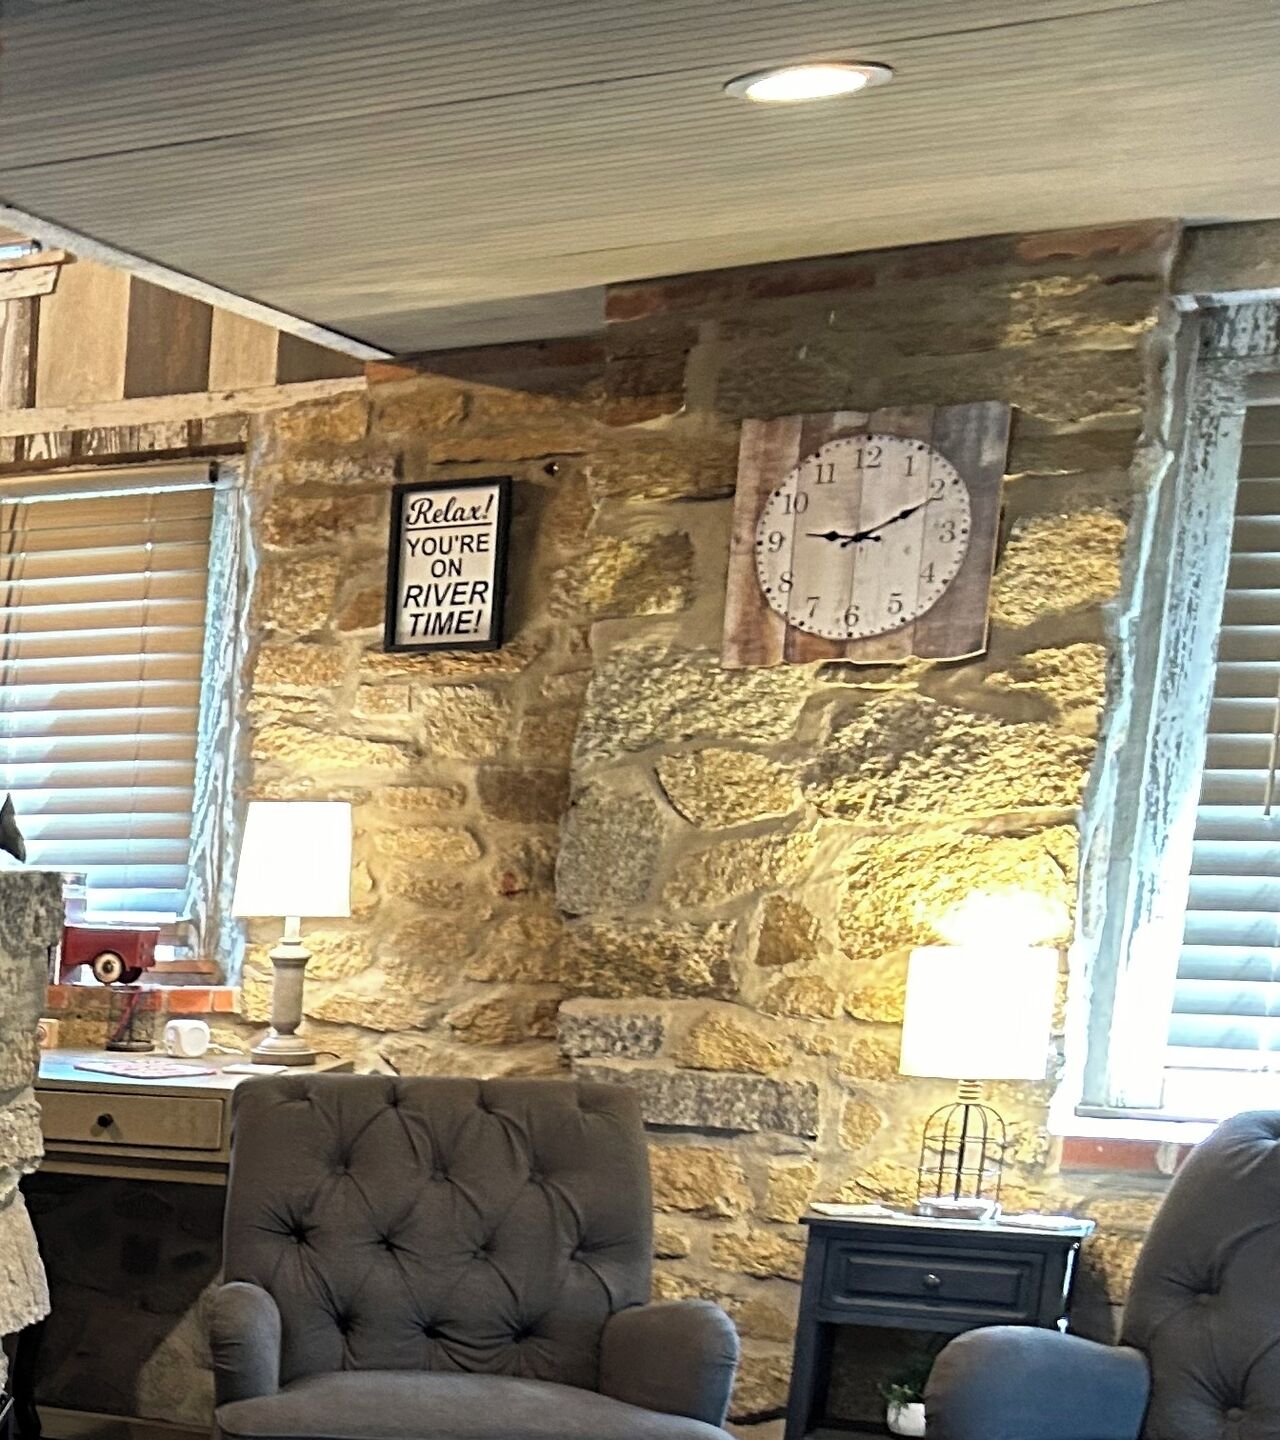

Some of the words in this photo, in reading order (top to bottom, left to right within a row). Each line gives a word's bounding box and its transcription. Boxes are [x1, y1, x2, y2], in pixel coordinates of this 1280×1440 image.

[856, 446, 883, 470] 12
[904, 455, 914, 477] 1
[815, 463, 836, 485] 11
[930, 479, 946, 501] 2
[406, 494, 494, 525] Relax!
[783, 491, 809, 515] 10
[768, 531, 785, 553] 9
[940, 521, 956, 544] 3
[406, 533, 490, 557] YOU'RE
[431, 557, 463, 578] ON
[920, 562, 935, 584] 4
[778, 571, 794, 593] 8
[403, 581, 489, 608] RIVER
[887, 593, 903, 614] 5
[806, 596, 821, 618] 7
[844, 605, 860, 627] 6
[409, 610, 483, 637] TIME!
